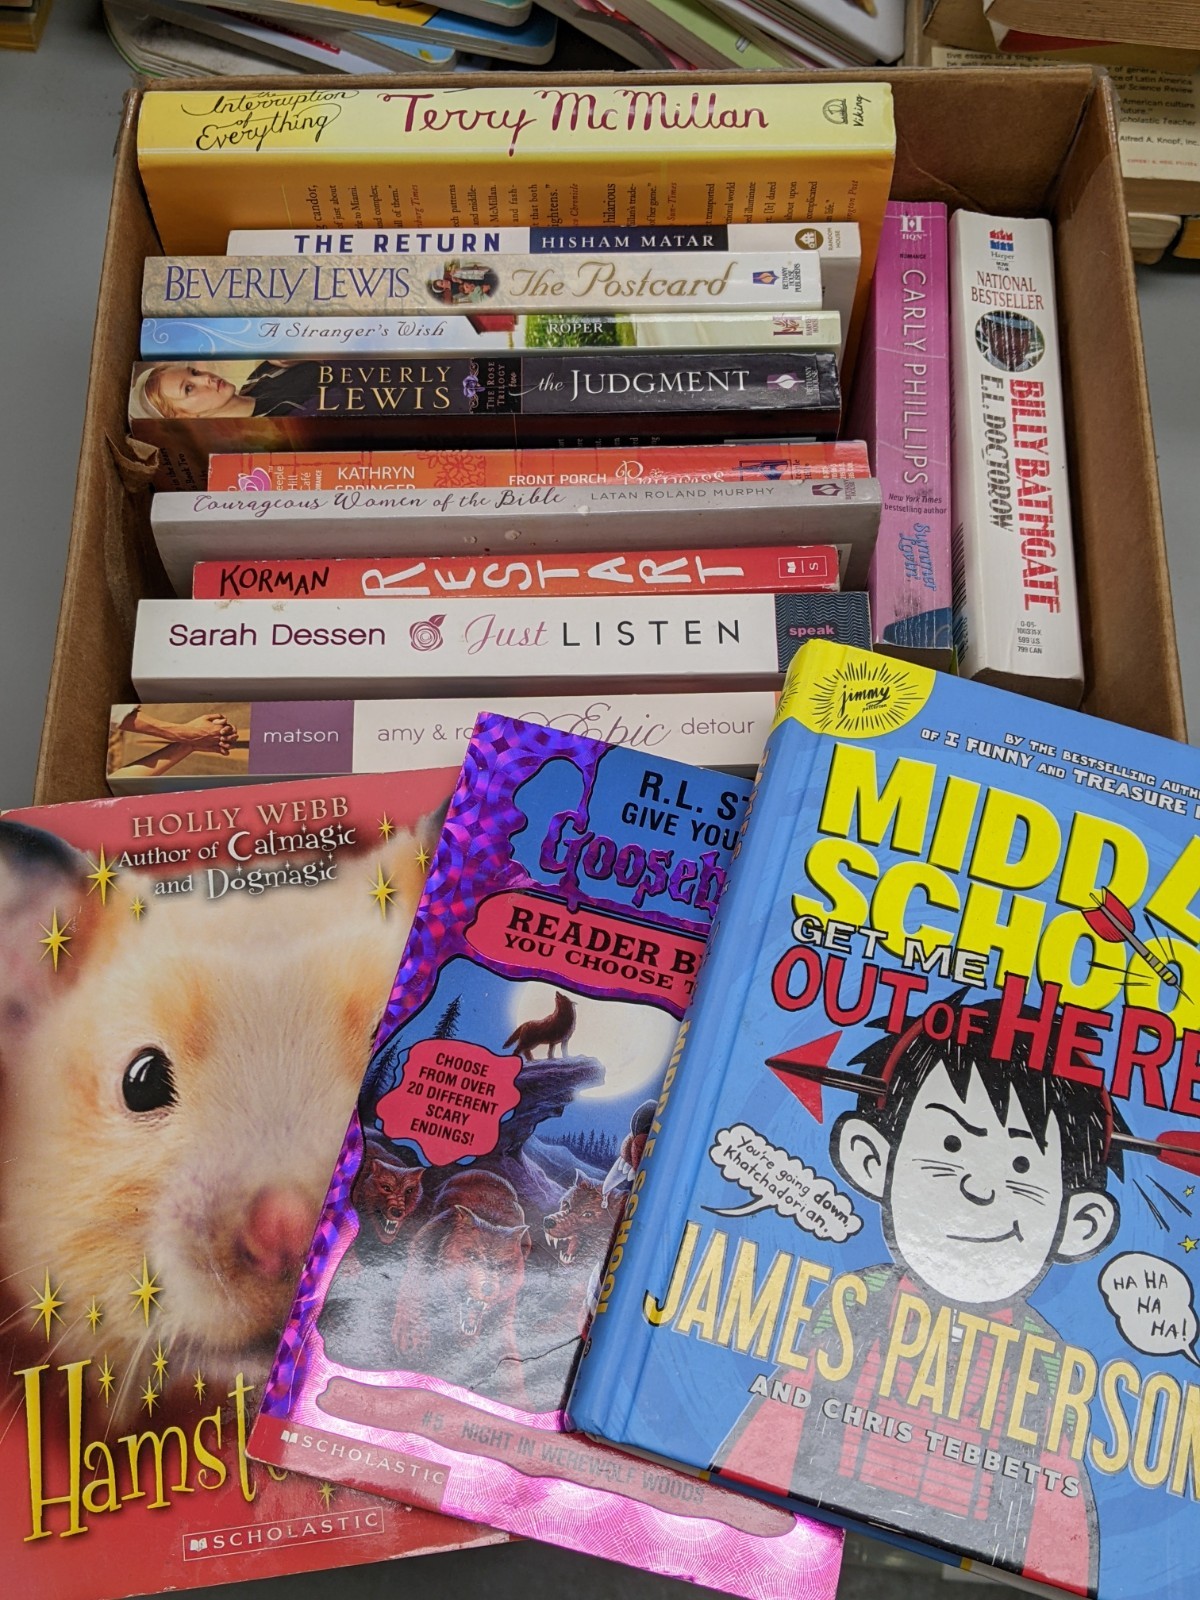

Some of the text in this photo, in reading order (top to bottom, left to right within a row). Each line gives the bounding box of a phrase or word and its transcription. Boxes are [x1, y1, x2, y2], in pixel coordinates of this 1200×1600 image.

[181, 89, 360, 116] Interruption
[196, 103, 342, 152] Everything
[377, 89, 769, 158] Terry McMillan
[306, 184, 322, 222] candor,
[329, 184, 344, 220] just about
[448, 184, 460, 213] patterns
[528, 184, 539, 220] that both
[603, 183, 616, 224] hilarious
[766, 181, 776, 201] dared
[788, 181, 799, 199] upon
[807, 181, 818, 220] complicated
[294, 232, 501, 254] THE RETURN
[541, 233, 715, 250] HISHAM MATAR
[164, 265, 411, 306] BEVERLY LEWIS
[509, 260, 739, 299] The Postcard
[976, 270, 1037, 293] NATIONAL
[970, 286, 1045, 311] BESTSELLER
[258, 320, 446, 343] A Stranger's Wish
[548, 322, 604, 335] ROPER
[319, 365, 452, 384] BEVERLY
[486, 361, 495, 409] THE ROSE
[497, 364, 505, 407] TRILOGY
[570, 369, 750, 402] JUDGMENT
[902, 269, 929, 486] CARLY PHILLIPS
[317, 386, 452, 411] LEWIS
[979, 373, 1014, 533] E.L. DOCTOROW
[337, 466, 415, 480] KATHRYN
[508, 474, 555, 486] FRONT
[559, 473, 607, 484] PORCH
[193, 486, 566, 517] Courageous Women of the Bible
[591, 486, 775, 501] LATAN ROLAND MURPHY
[884, 503, 947, 515] bestselling author
[888, 492, 943, 504] New York Times
[1009, 378, 1061, 614] BILLY BATHGATE
[913, 522, 937, 592] Summer
[220, 554, 745, 597] KORMAN RESTART
[169, 622, 386, 647] Sarah Dessen
[463, 613, 740, 655] Just LISTEN
[789, 623, 835, 638] speak
[837, 684, 891, 719] jimmy
[263, 727, 340, 743] matson
[377, 726, 425, 745] amy
[432, 723, 447, 741] &
[681, 717, 756, 736] detour
[920, 728, 941, 743] OF
[943, 732, 960, 749] I
[966, 735, 1034, 769] FUNNY
[1037, 761, 1066, 780] AND
[1072, 768, 1188, 816] TREASURE
[1004, 733, 1157, 787] BY THE BESTSELLING
[639, 769, 703, 814] R.L.
[132, 796, 349, 838] HOLLY WEBB
[621, 801, 678, 837] GIVE
[118, 824, 357, 869] Author of Catmagic
[154, 858, 338, 900] and Dogmagic
[506, 904, 662, 968] READER
[791, 913, 990, 989] GET ME
[504, 932, 675, 991] YOU CHOOSE
[771, 945, 929, 1035] OUT
[922, 1002, 989, 1047] OF
[418, 1066, 496, 1098] FROM OVER
[435, 1052, 490, 1078] CHOOSE
[406, 1080, 499, 1116] 20 DIFFERENT
[425, 1103, 471, 1126] SCARY
[410, 1118, 476, 1147] ENDINGS!
[723, 1145, 829, 1233] Khatchadorian.
[736, 1135, 850, 1228] You're going down,
[1113, 1269, 1168, 1290] HA HA
[643, 1218, 870, 1384] JAMES
[1137, 1295, 1161, 1315] HA
[1150, 1317, 1187, 1342] HA!
[748, 1373, 1081, 1500] AND CHRIS TEBBETTS
[301, 1434, 447, 1486] SCHOLASTIC
[461, 1420, 515, 1450] NIGHT
[518, 1436, 537, 1459] IN
[642, 1468, 705, 1505] WOODS
[213, 1512, 379, 1551] SCHOLASTIC
